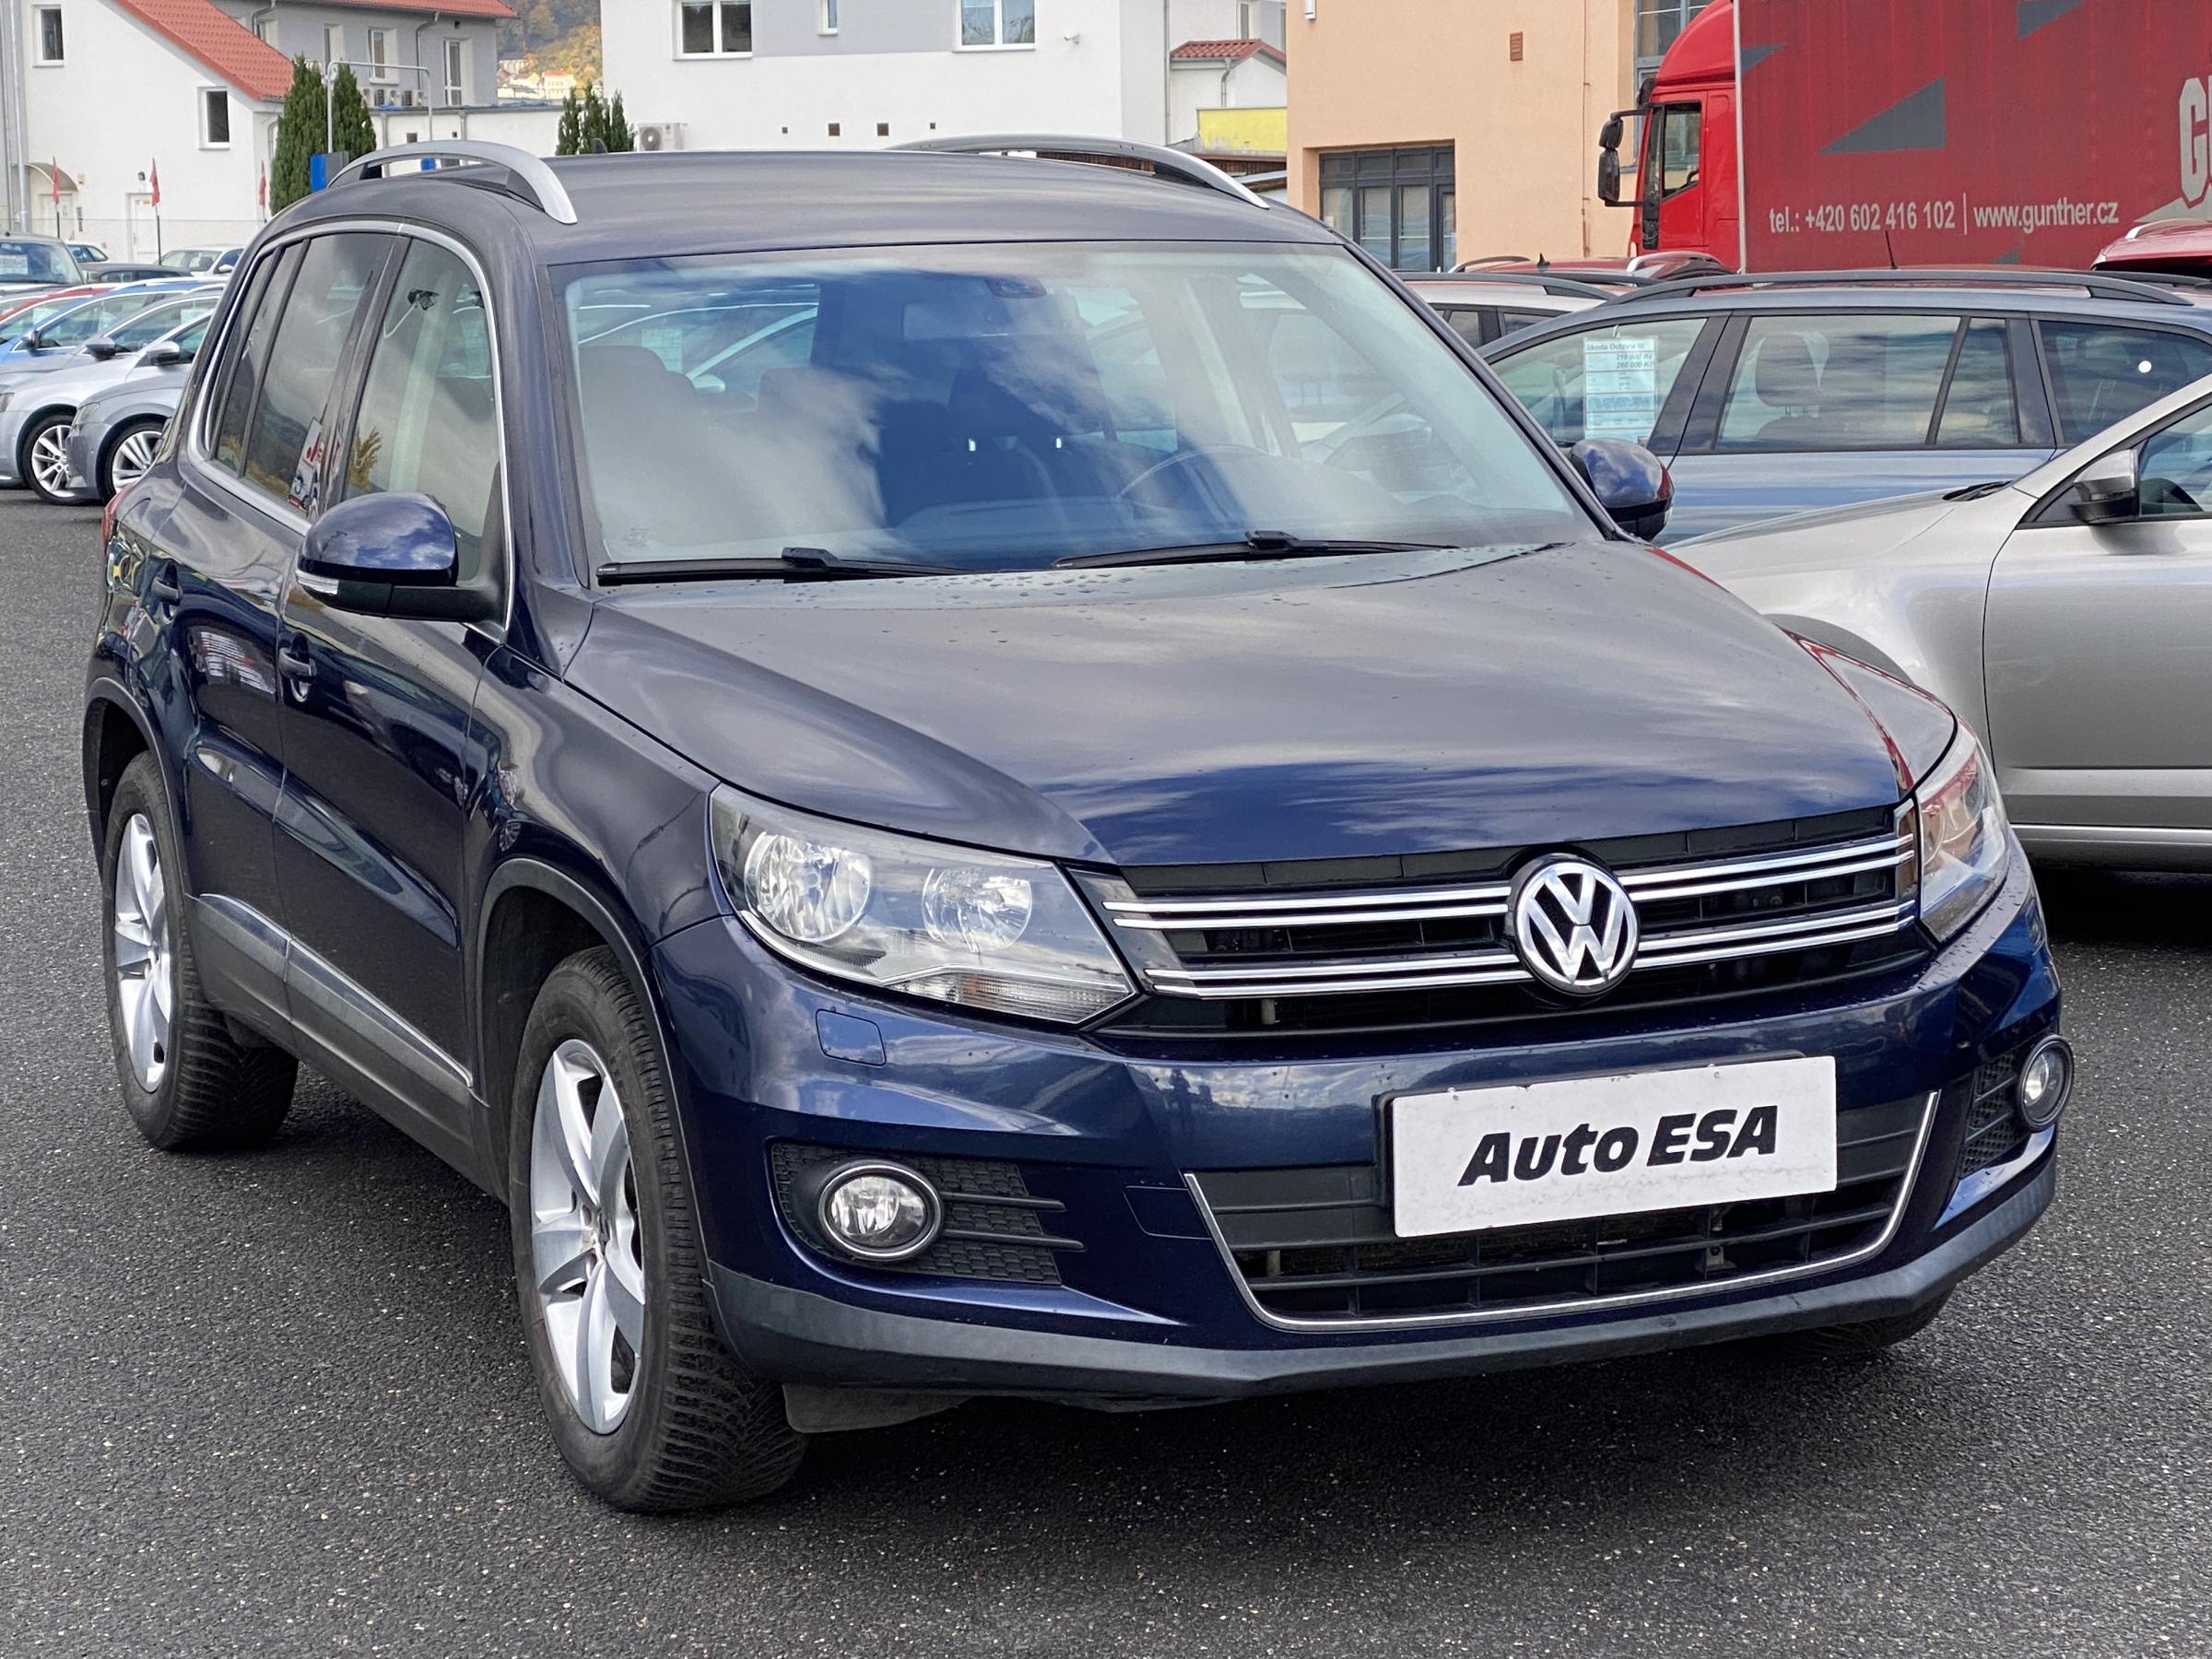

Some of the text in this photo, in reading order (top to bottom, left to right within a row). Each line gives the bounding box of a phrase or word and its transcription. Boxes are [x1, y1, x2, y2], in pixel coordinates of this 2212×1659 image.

[2179, 76, 2212, 202] G
[1769, 196, 2119, 235] tel.: +420 602 416 102 www.gunther.cz
[1519, 865, 1636, 985] VW
[1457, 1104, 1778, 1187] Auto ESA
